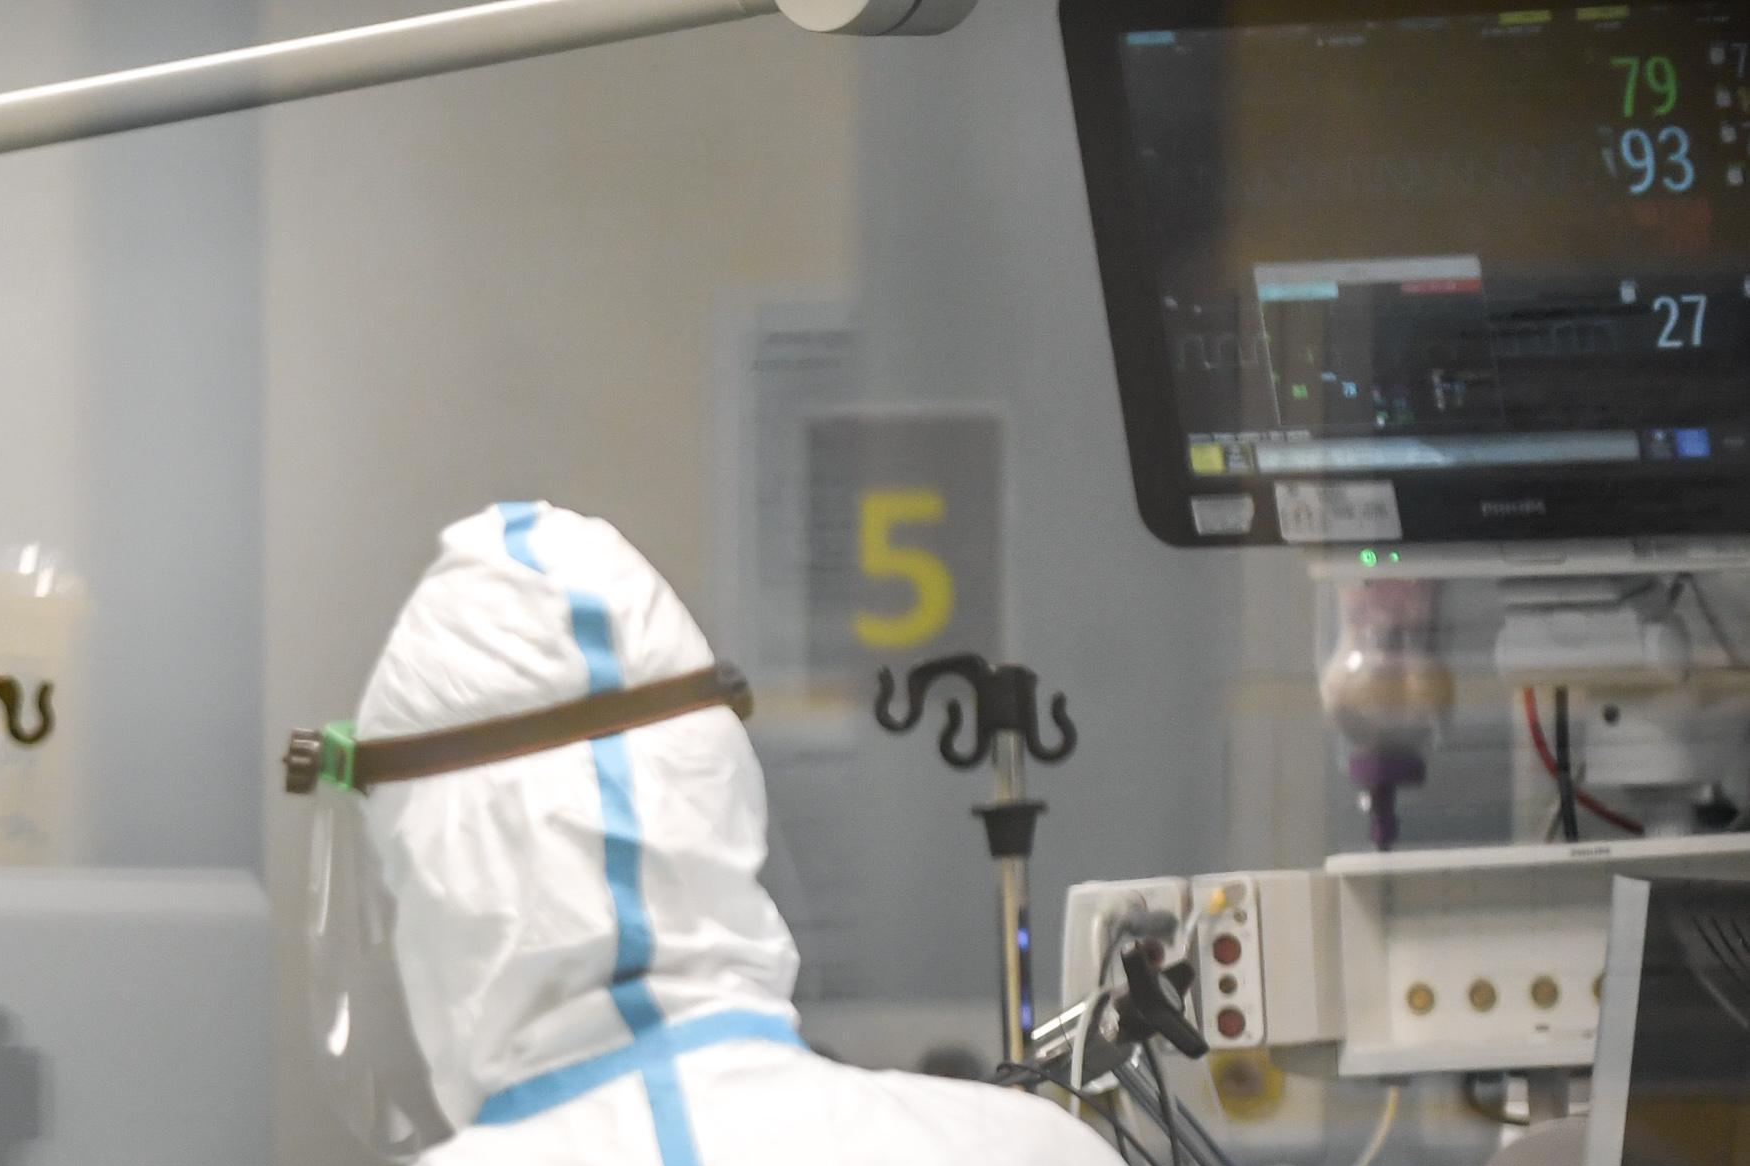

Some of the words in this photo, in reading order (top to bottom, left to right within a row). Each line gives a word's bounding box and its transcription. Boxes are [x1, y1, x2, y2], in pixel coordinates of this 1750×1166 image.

[1610, 56, 1677, 117] 79
[1620, 126, 1695, 193] 93
[1653, 294, 1706, 348] 27
[854, 485, 954, 650] 5
